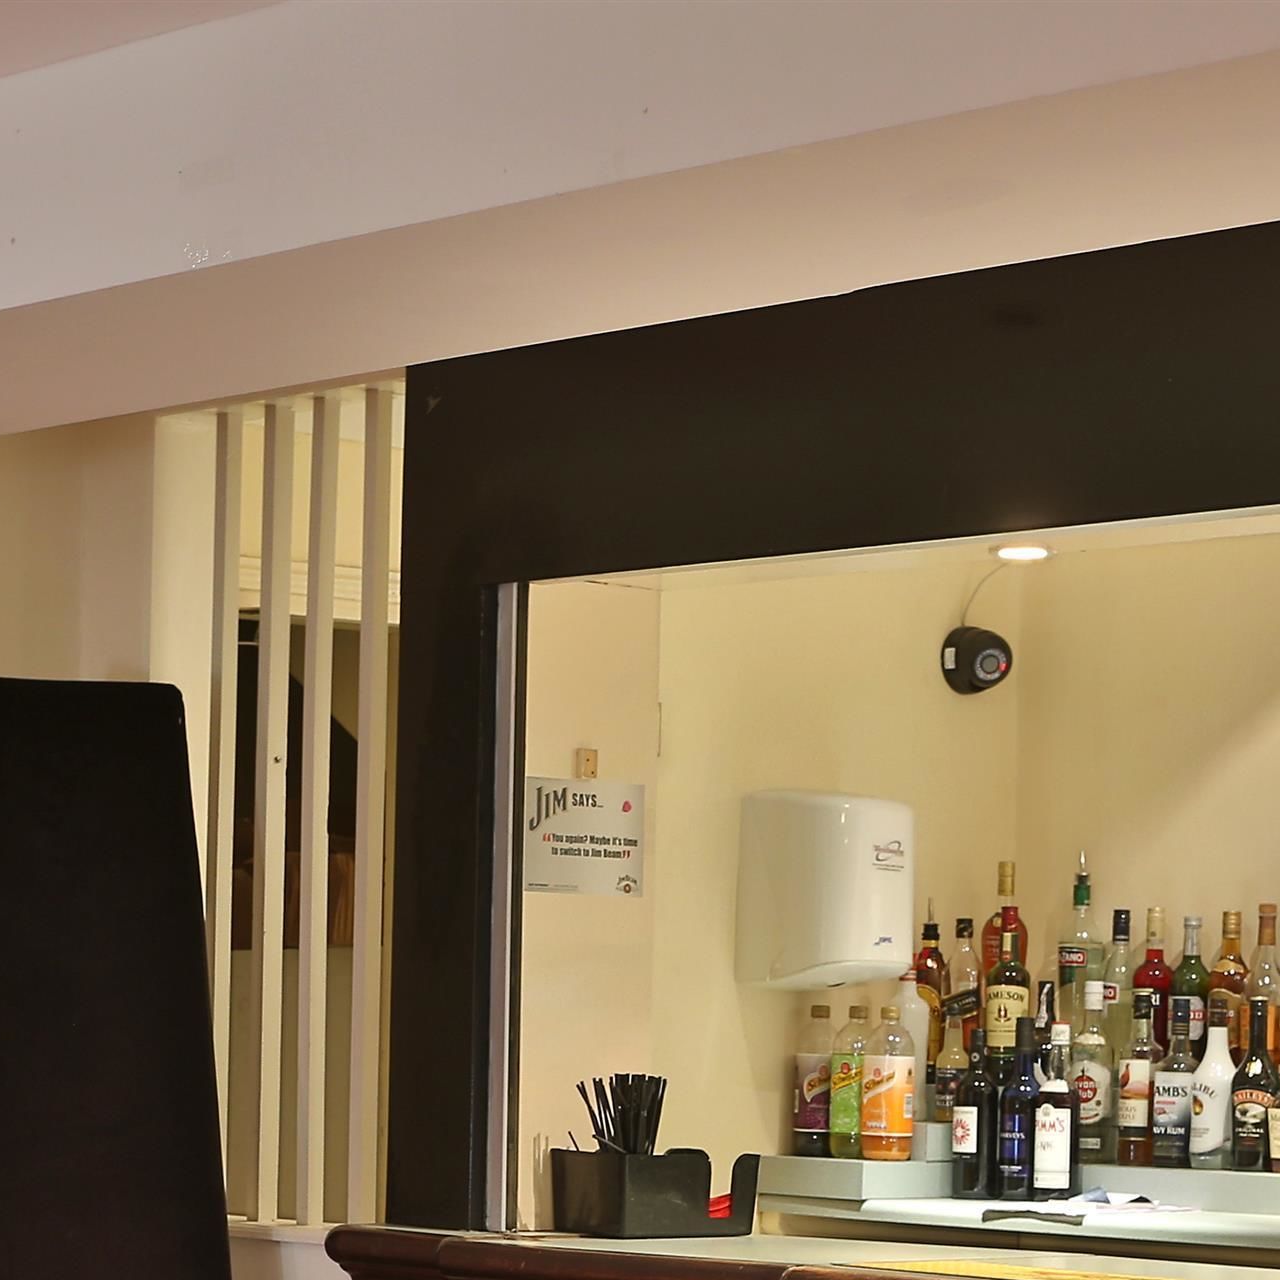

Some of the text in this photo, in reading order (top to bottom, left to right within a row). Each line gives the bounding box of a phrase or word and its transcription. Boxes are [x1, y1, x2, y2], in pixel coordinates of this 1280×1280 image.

[529, 786, 567, 831] JIM
[565, 835, 588, 845] again?
[589, 836, 610, 846] Maybe
[623, 838, 638, 847] time
[551, 847, 558, 855] to
[560, 847, 582, 857] switch
[583, 848, 590, 857] to
[591, 848, 602, 858] Jim
[1035, 1117, 1065, 1133] IMM'S
